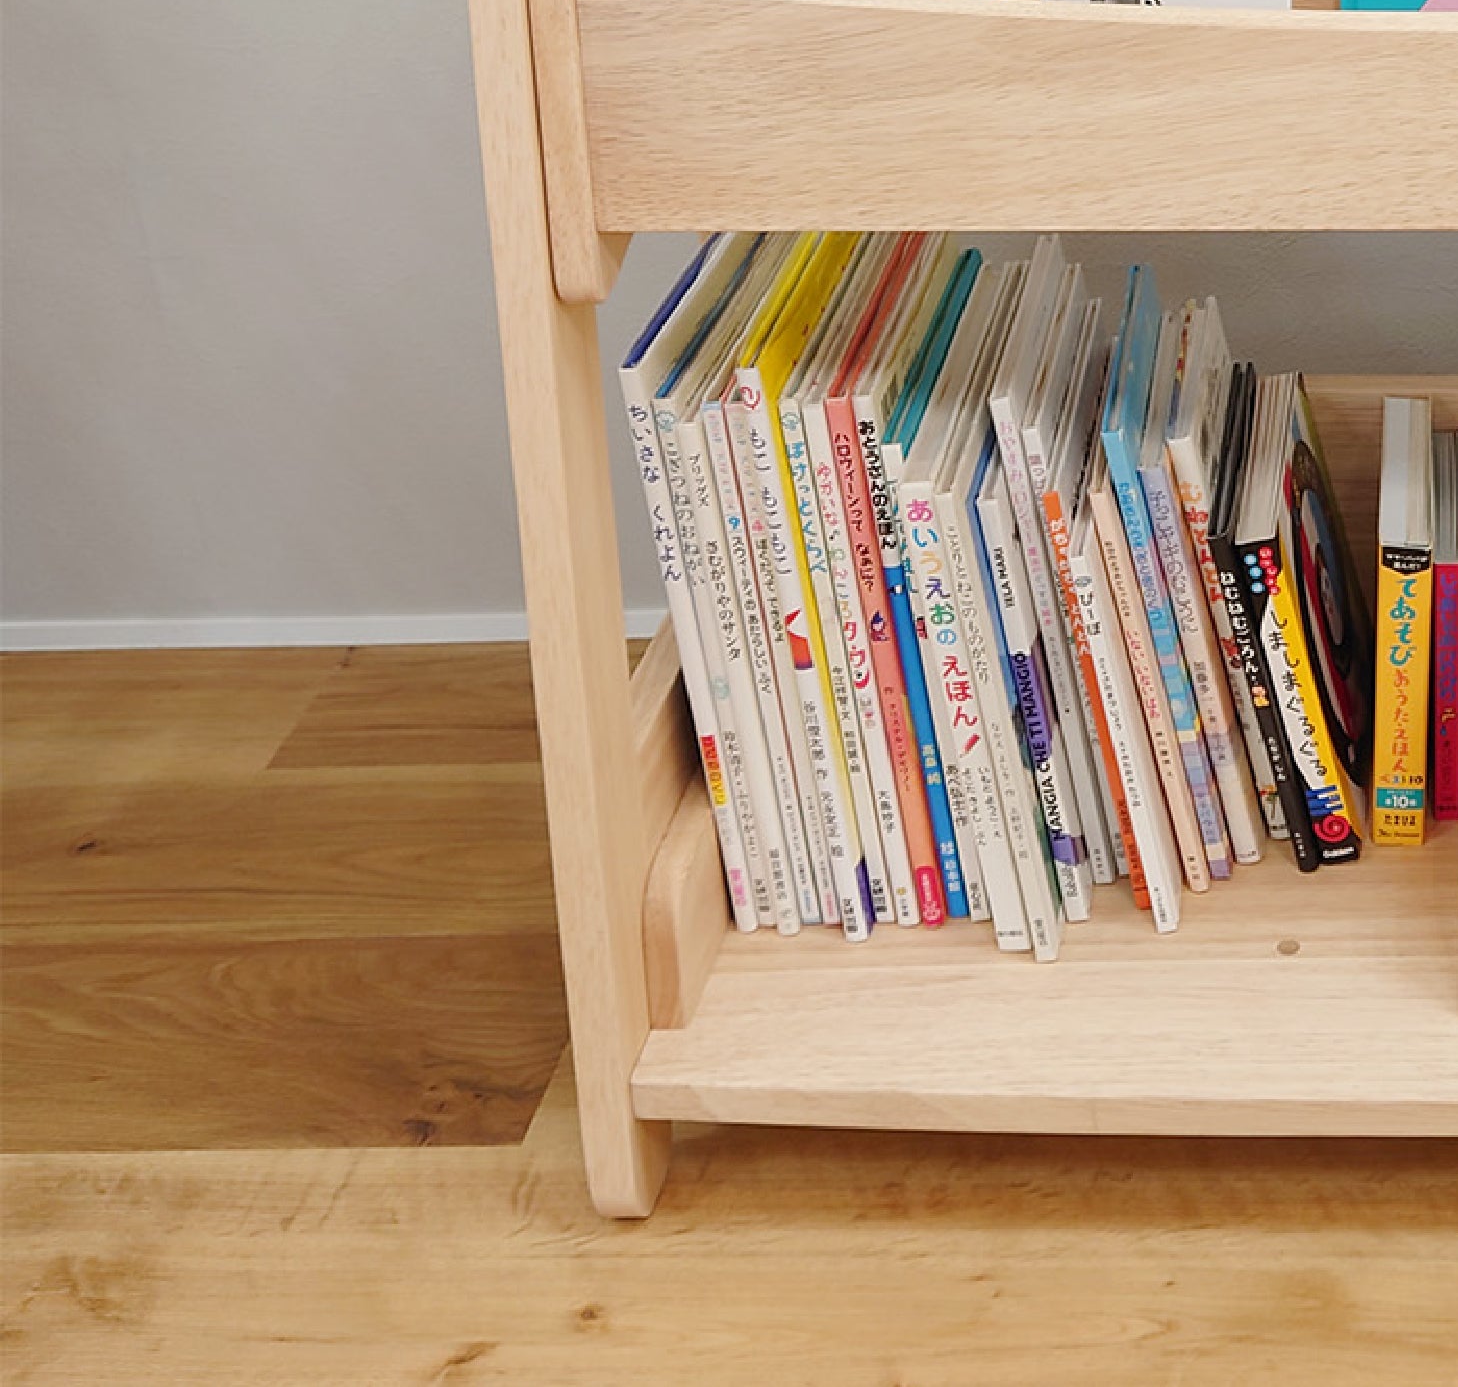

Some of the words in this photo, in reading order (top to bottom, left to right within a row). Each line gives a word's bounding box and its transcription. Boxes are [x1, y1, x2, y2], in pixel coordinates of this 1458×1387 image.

[628, 406, 660, 483] ちいさな
[653, 505, 682, 582] くれよん
[857, 420, 898, 550] おとうさんのえほん
[905, 499, 958, 645] あいうえおの
[942, 655, 978, 728] えほん
[1389, 579, 1417, 666] てあそび
[1015, 651, 1037, 718] MANGIO
[1271, 611, 1328, 776] しましまぐるぐる
[1028, 719, 1042, 738] TI
[1033, 741, 1051, 773] CHE
[1040, 775, 1066, 841] MANGIA
